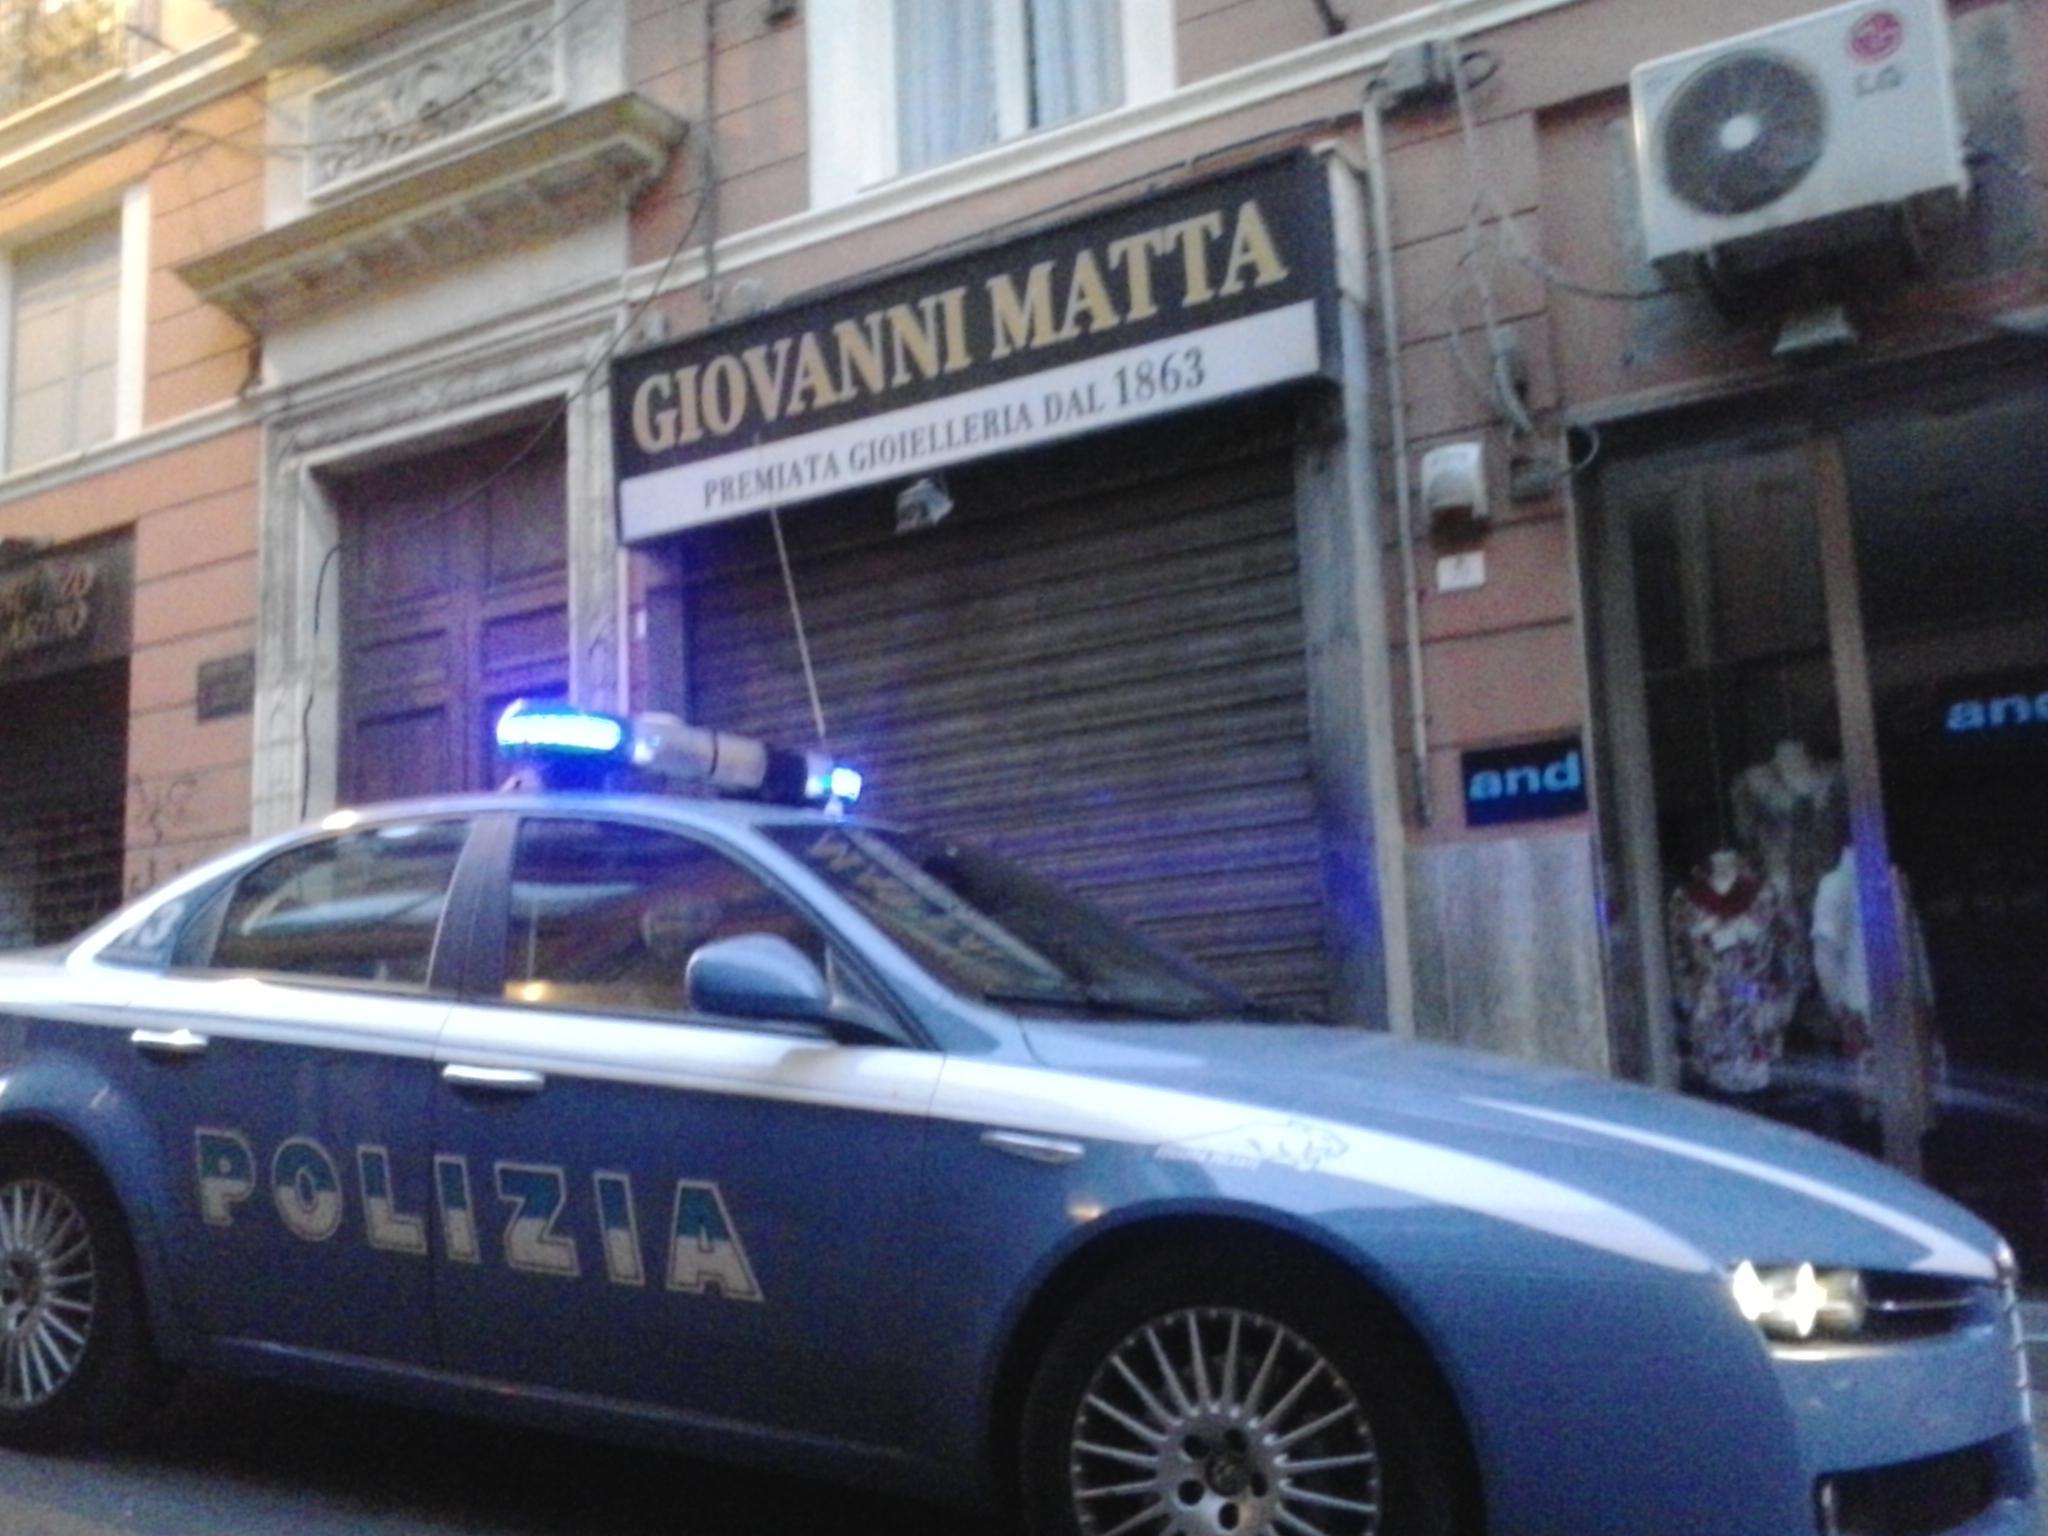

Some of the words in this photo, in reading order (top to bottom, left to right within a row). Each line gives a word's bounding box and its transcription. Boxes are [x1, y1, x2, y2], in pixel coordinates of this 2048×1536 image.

[632, 286, 972, 455] GIOVANNI
[985, 199, 1289, 361] MATTA
[703, 450, 840, 509] PREMIATA
[848, 401, 1033, 472] GIOIELLERIA
[1043, 380, 1106, 426] DAL
[1112, 346, 1206, 408] 1863
[1469, 751, 1581, 801] and
[194, 1126, 765, 1302] POLIZIA
